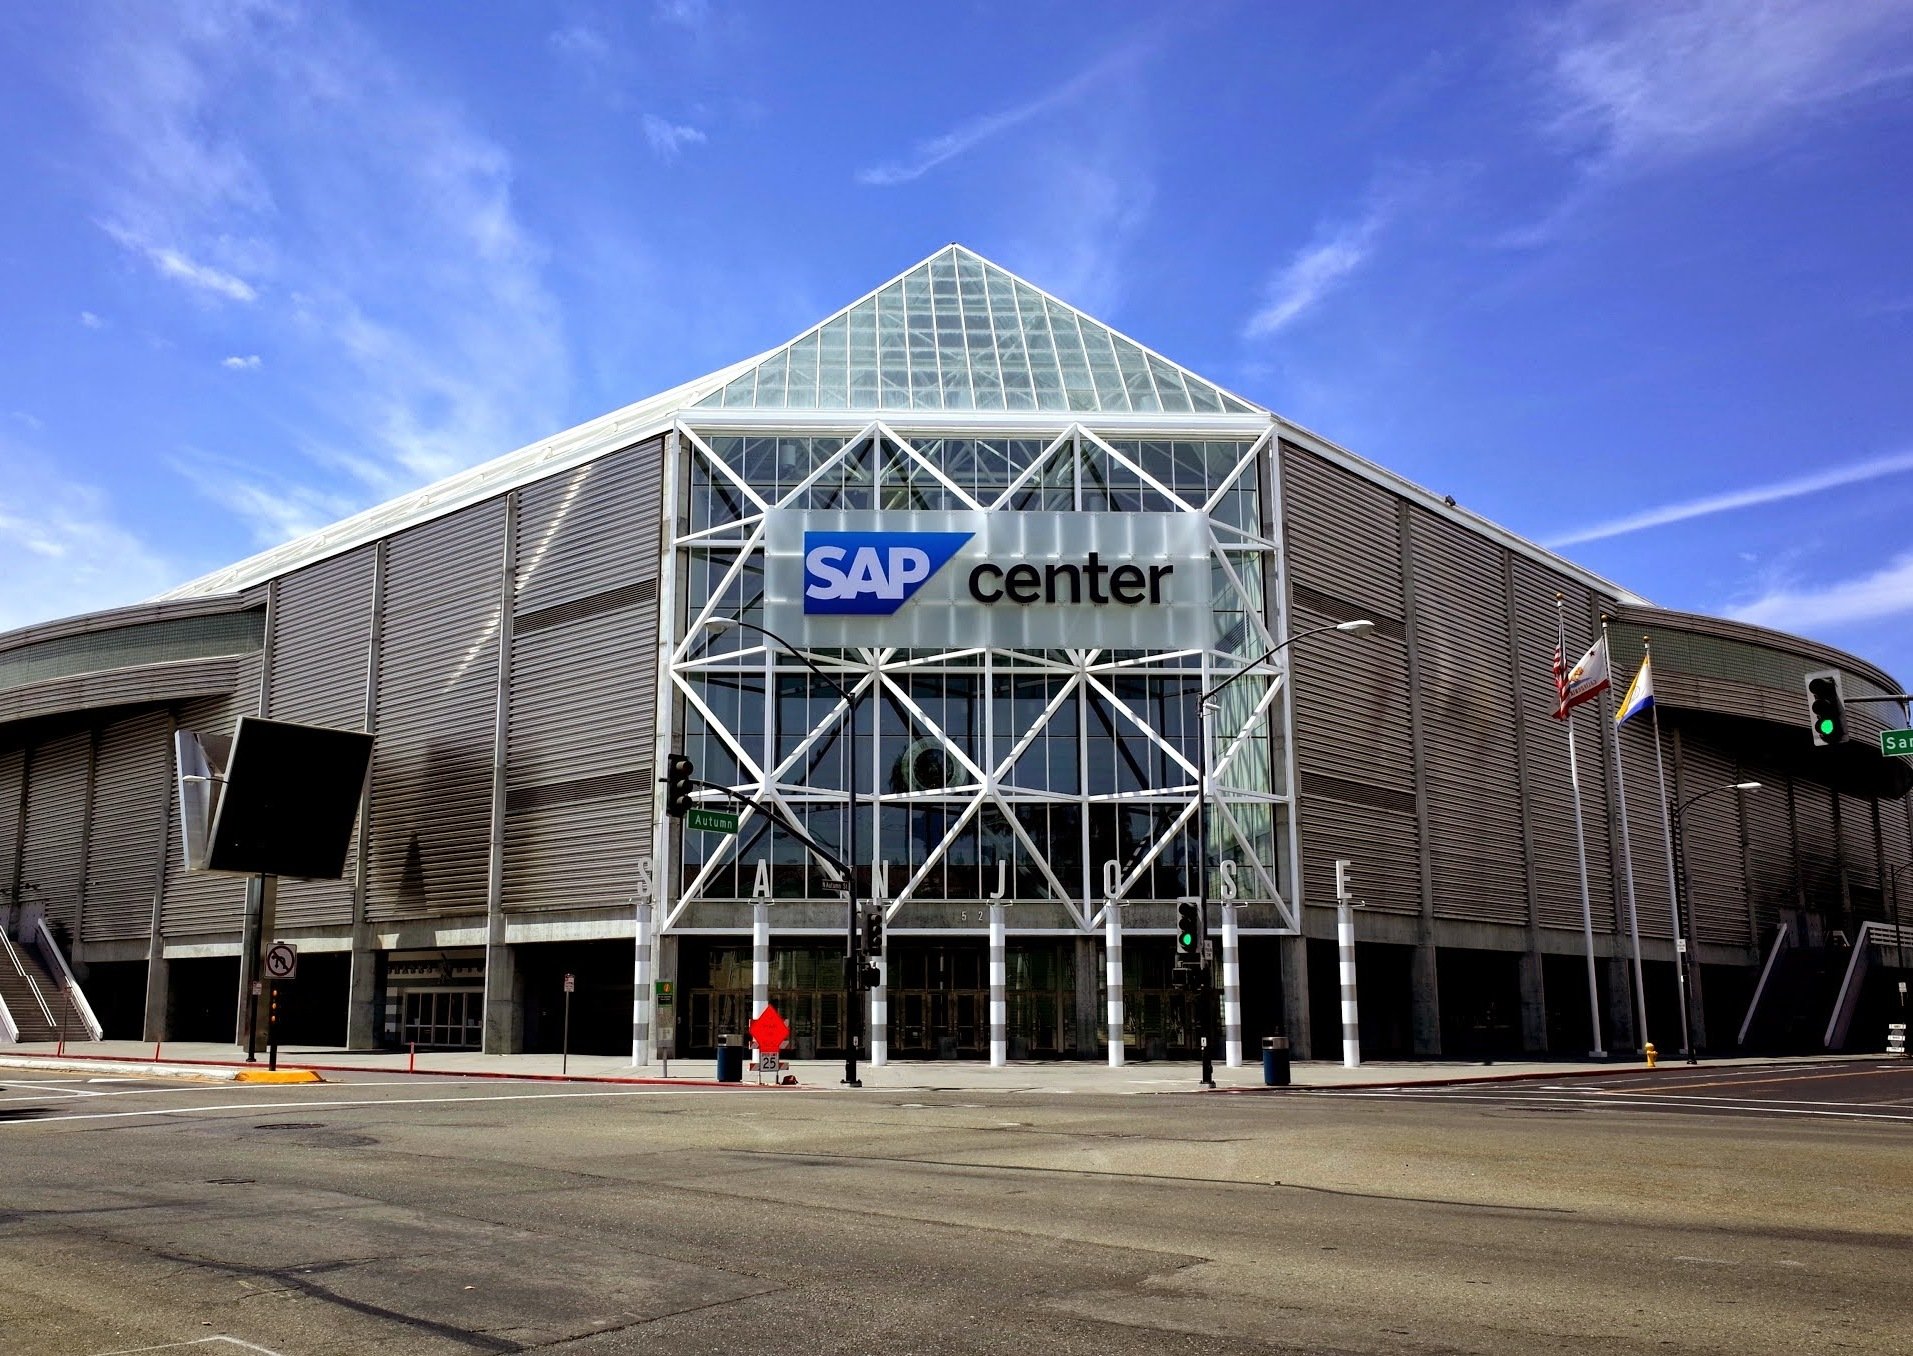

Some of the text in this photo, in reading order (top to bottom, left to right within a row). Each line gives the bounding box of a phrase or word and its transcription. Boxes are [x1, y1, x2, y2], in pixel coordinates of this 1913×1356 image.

[805, 545, 1174, 604] SAP center
[695, 814, 733, 829] Autumn
[763, 1057, 776, 1069] 25
